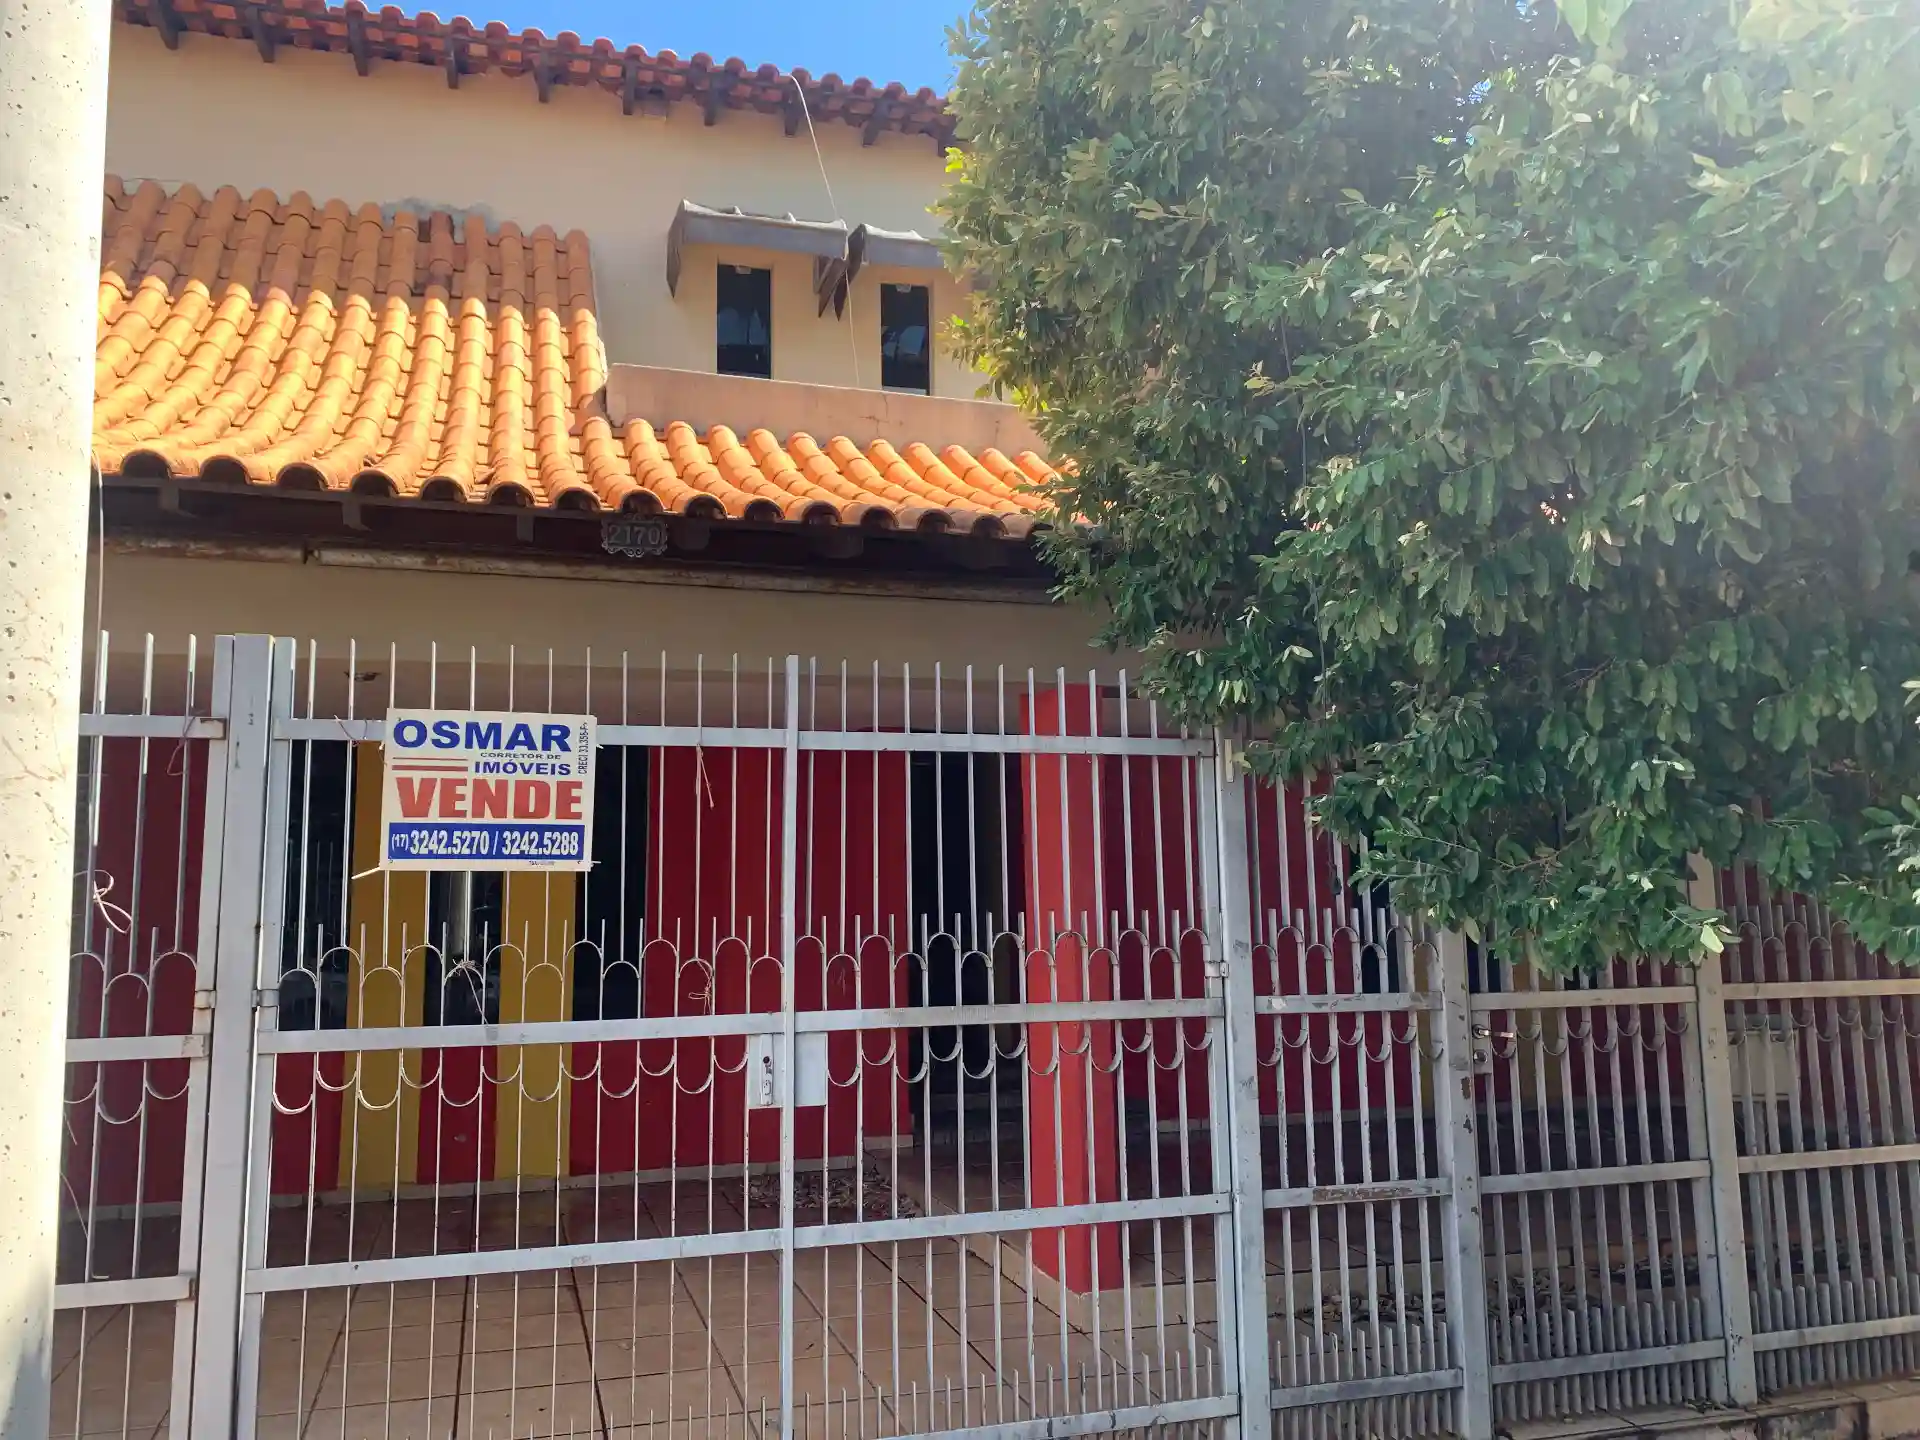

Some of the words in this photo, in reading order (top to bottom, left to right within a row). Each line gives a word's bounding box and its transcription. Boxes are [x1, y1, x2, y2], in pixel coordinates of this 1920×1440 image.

[608, 524, 661, 545] 2170
[393, 719, 572, 753] OSMAR
[480, 752, 543, 760] CORRETOR
[546, 753, 562, 761] DE
[577, 754, 588, 775] CRECI
[474, 759, 572, 776] IMÓVEIS
[395, 776, 583, 820] VENDE
[391, 832, 409, 851] (17)
[410, 829, 490, 855] 3242.5270
[501, 830, 579, 856] 3242.5288
